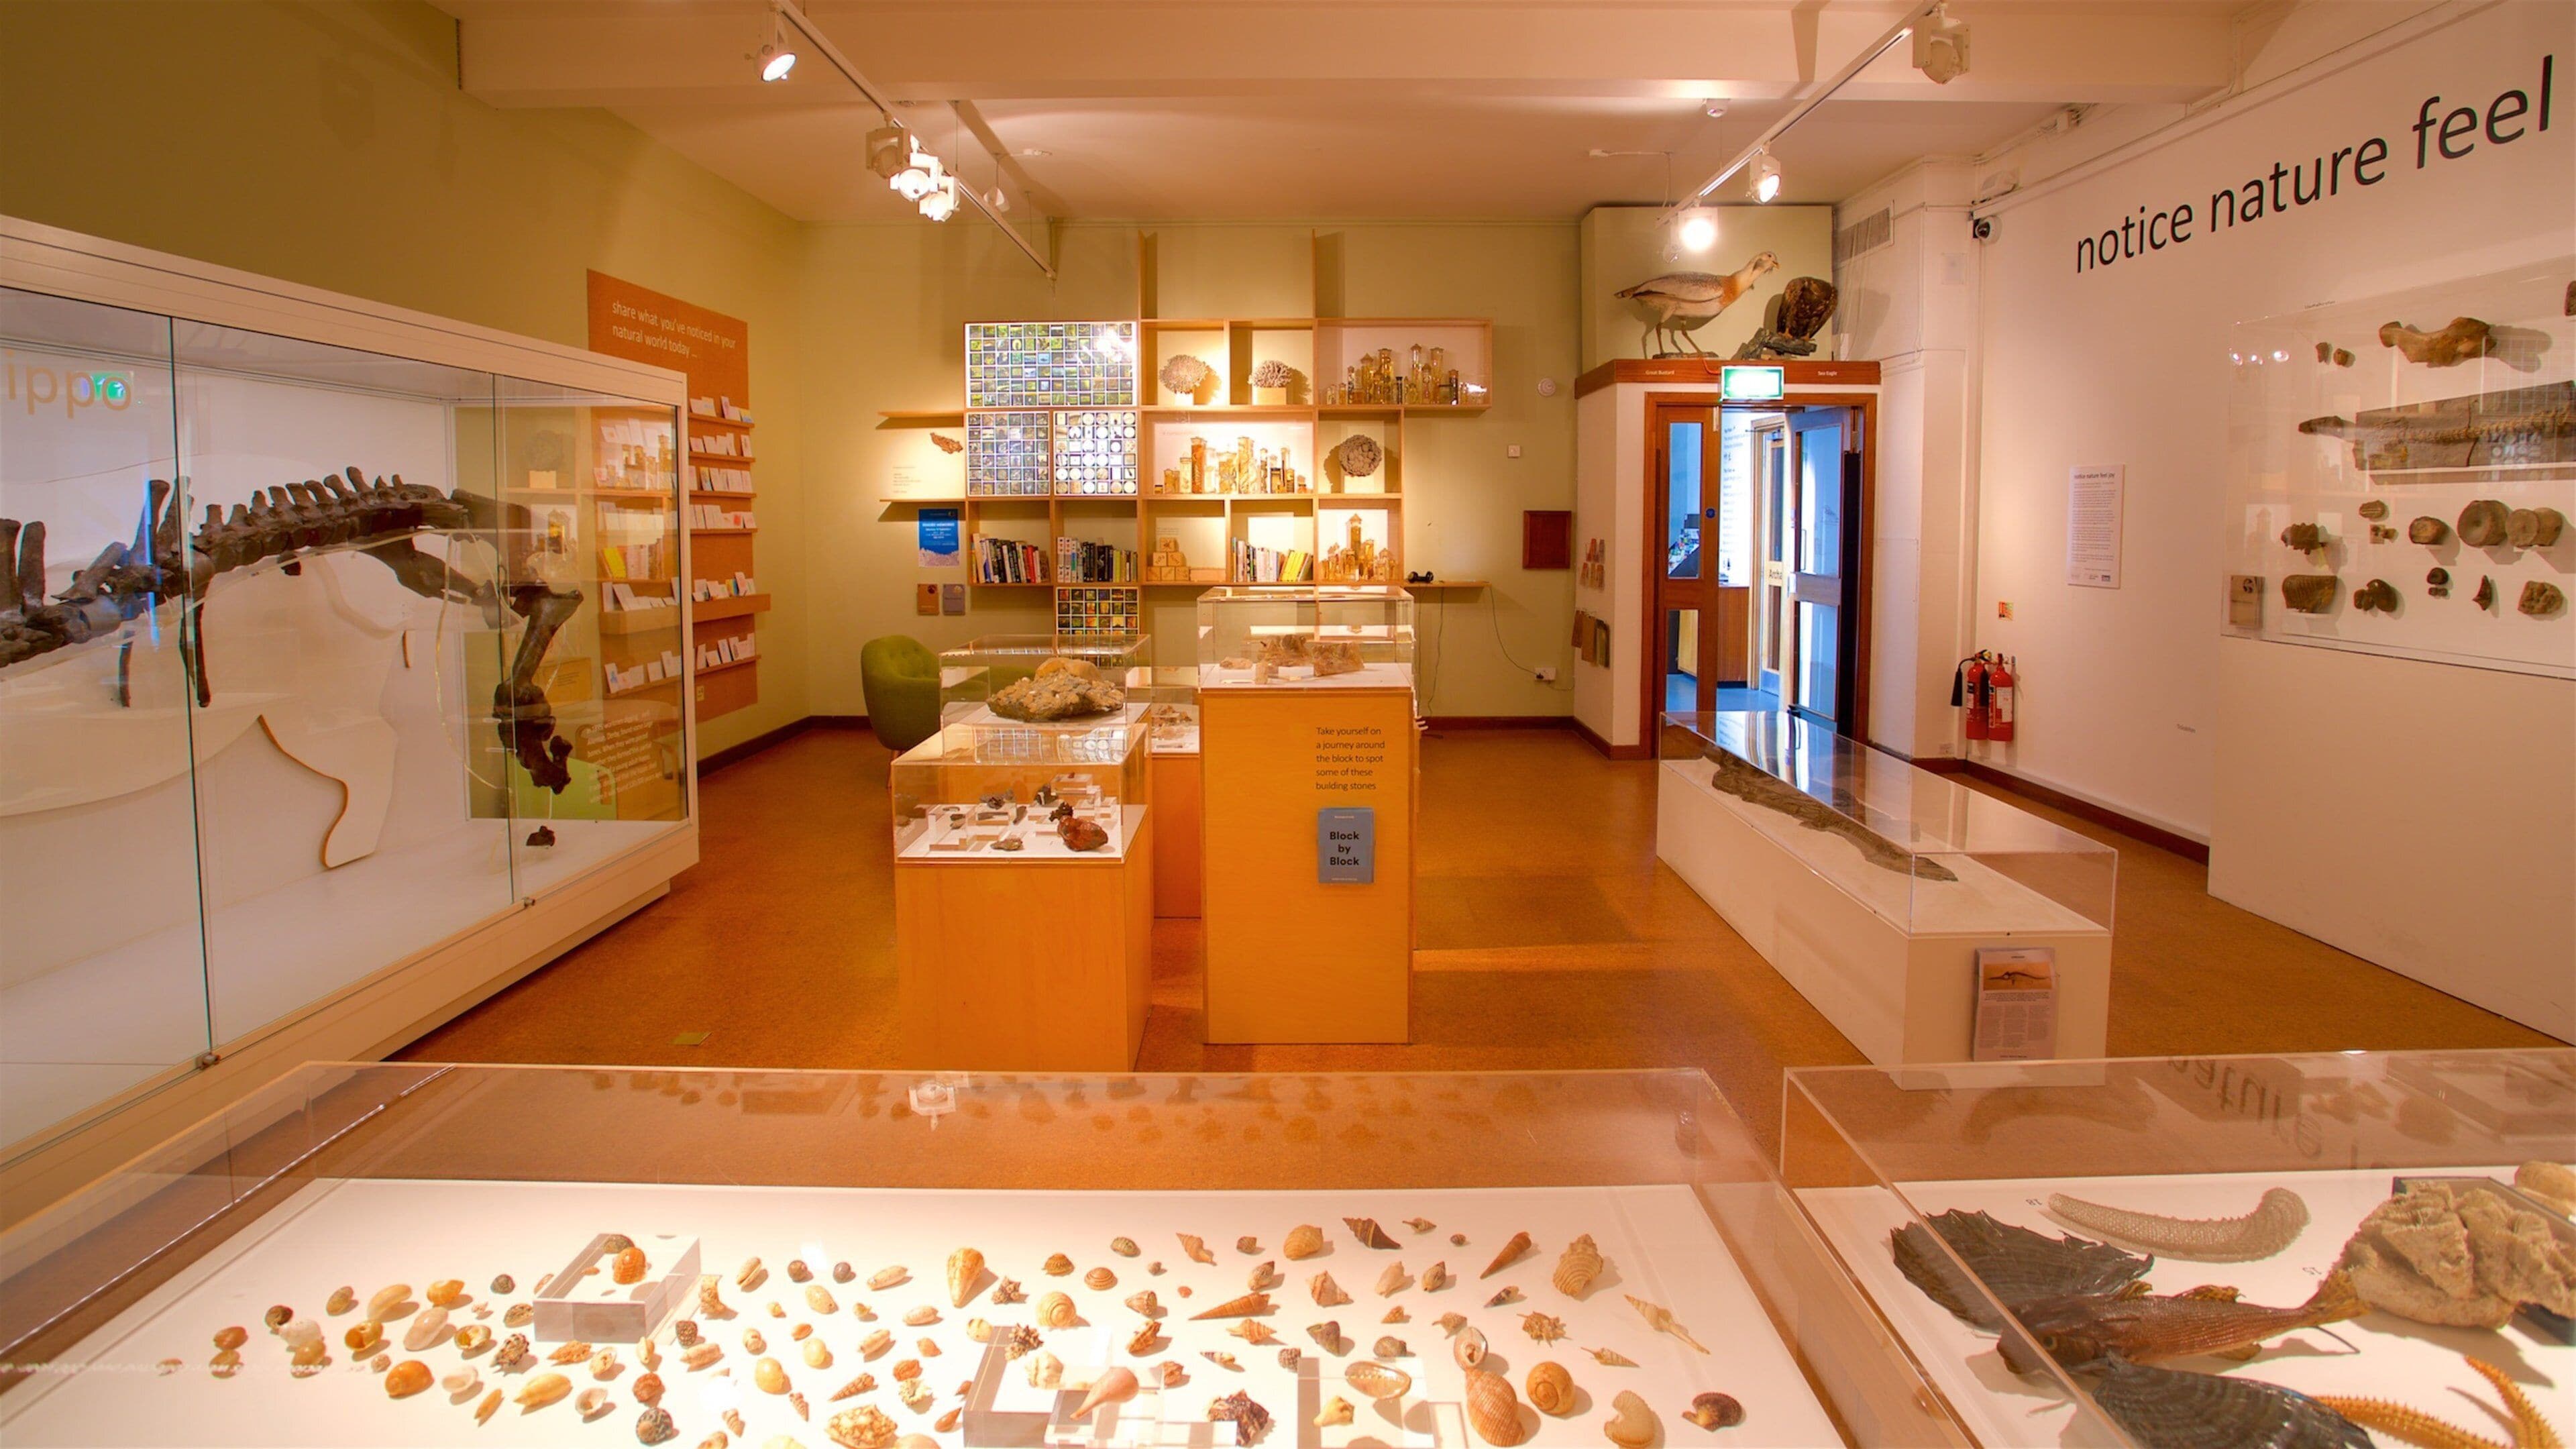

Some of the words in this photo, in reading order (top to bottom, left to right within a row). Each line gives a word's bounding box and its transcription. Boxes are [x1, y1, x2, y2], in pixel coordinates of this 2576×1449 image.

[2077, 205, 2193, 274] notice
[2210, 137, 2388, 233] nature
[2412, 54, 2553, 170] feel
[612, 301, 636, 319] share
[638, 309, 658, 326] what
[687, 327, 712, 342] noticed
[713, 332, 720, 344] in
[722, 336, 736, 349] your
[612, 325, 643, 343] natural
[644, 335, 667, 350] world
[669, 339, 691, 359] today
[1316, 727, 1335, 736] Take
[1336, 726, 1369, 737] yourself
[1322, 741, 1354, 751] journey
[1356, 741, 1385, 749] around
[1316, 755, 1330, 763] the
[1332, 755, 1354, 763] block
[1355, 755, 1364, 763] to
[1366, 755, 1384, 764] spot
[1316, 769, 1339, 777] some
[1340, 767, 1349, 777] of
[1350, 768, 1373, 777] these
[1316, 781, 1348, 792] building
[1330, 831, 1360, 841] Block
[1338, 844, 1351, 855] by
[1330, 857, 1360, 866] Block
